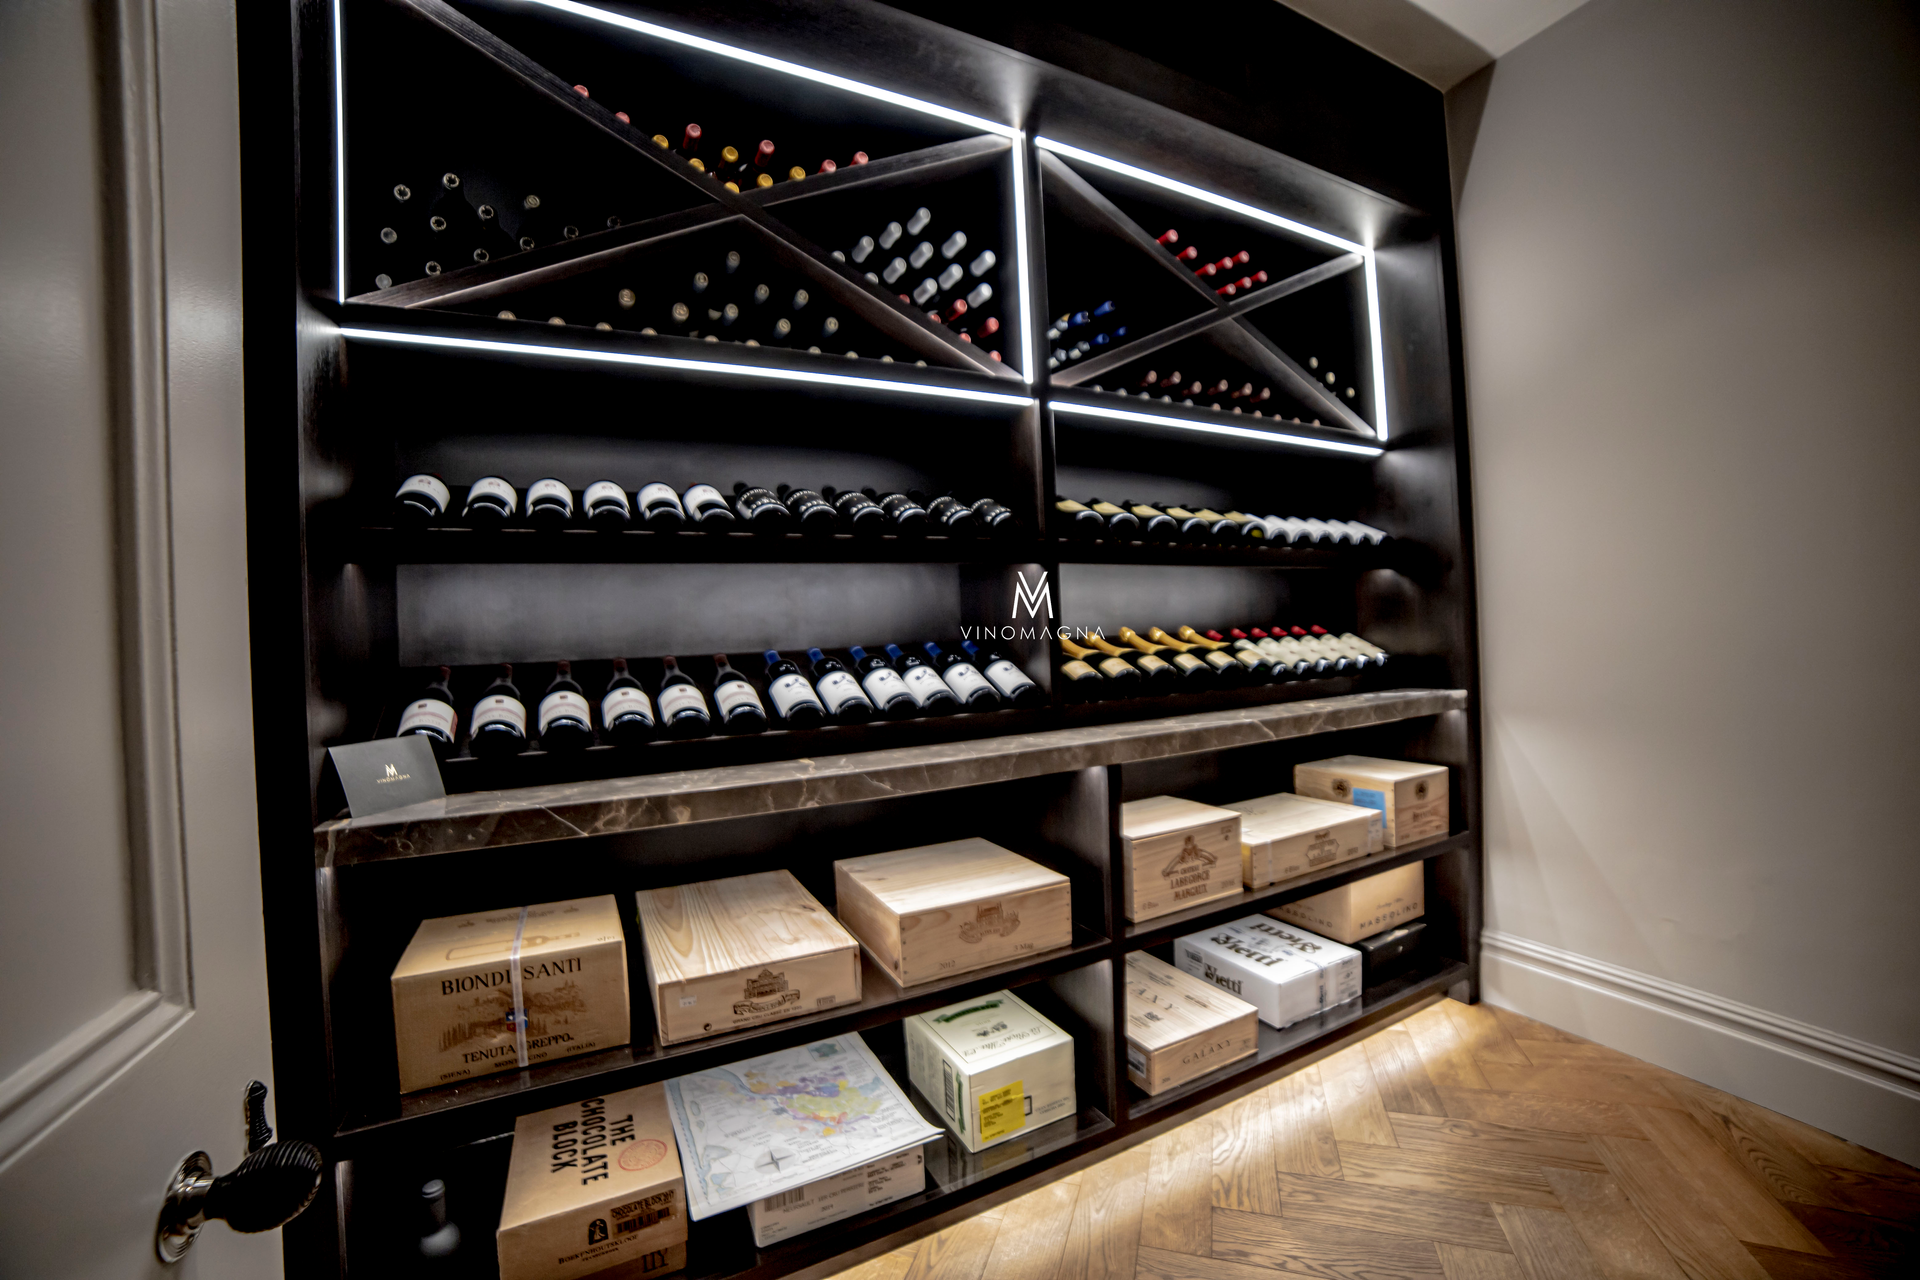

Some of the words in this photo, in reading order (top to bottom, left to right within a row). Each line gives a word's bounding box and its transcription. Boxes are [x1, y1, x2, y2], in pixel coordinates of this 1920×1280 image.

[376, 773, 411, 784] VINOMAGNA
[1170, 869, 1211, 890] LABEGORCE
[1173, 883, 1208, 901] MARGAUX
[1359, 902, 1418, 930] MASSOLINO
[1211, 933, 1284, 967] Vietti
[441, 970, 512, 996] BIONDI
[523, 957, 582, 981] SANTI
[1204, 962, 1242, 996] Vietti
[732, 1016, 751, 1024] GRAND
[462, 1043, 516, 1065] TENUTA
[1182, 1040, 1231, 1065] GALAXY
[580, 1098, 609, 1186] CHOCOLATE
[609, 1114, 636, 1147] THE
[551, 1120, 578, 1174] BLOCK
